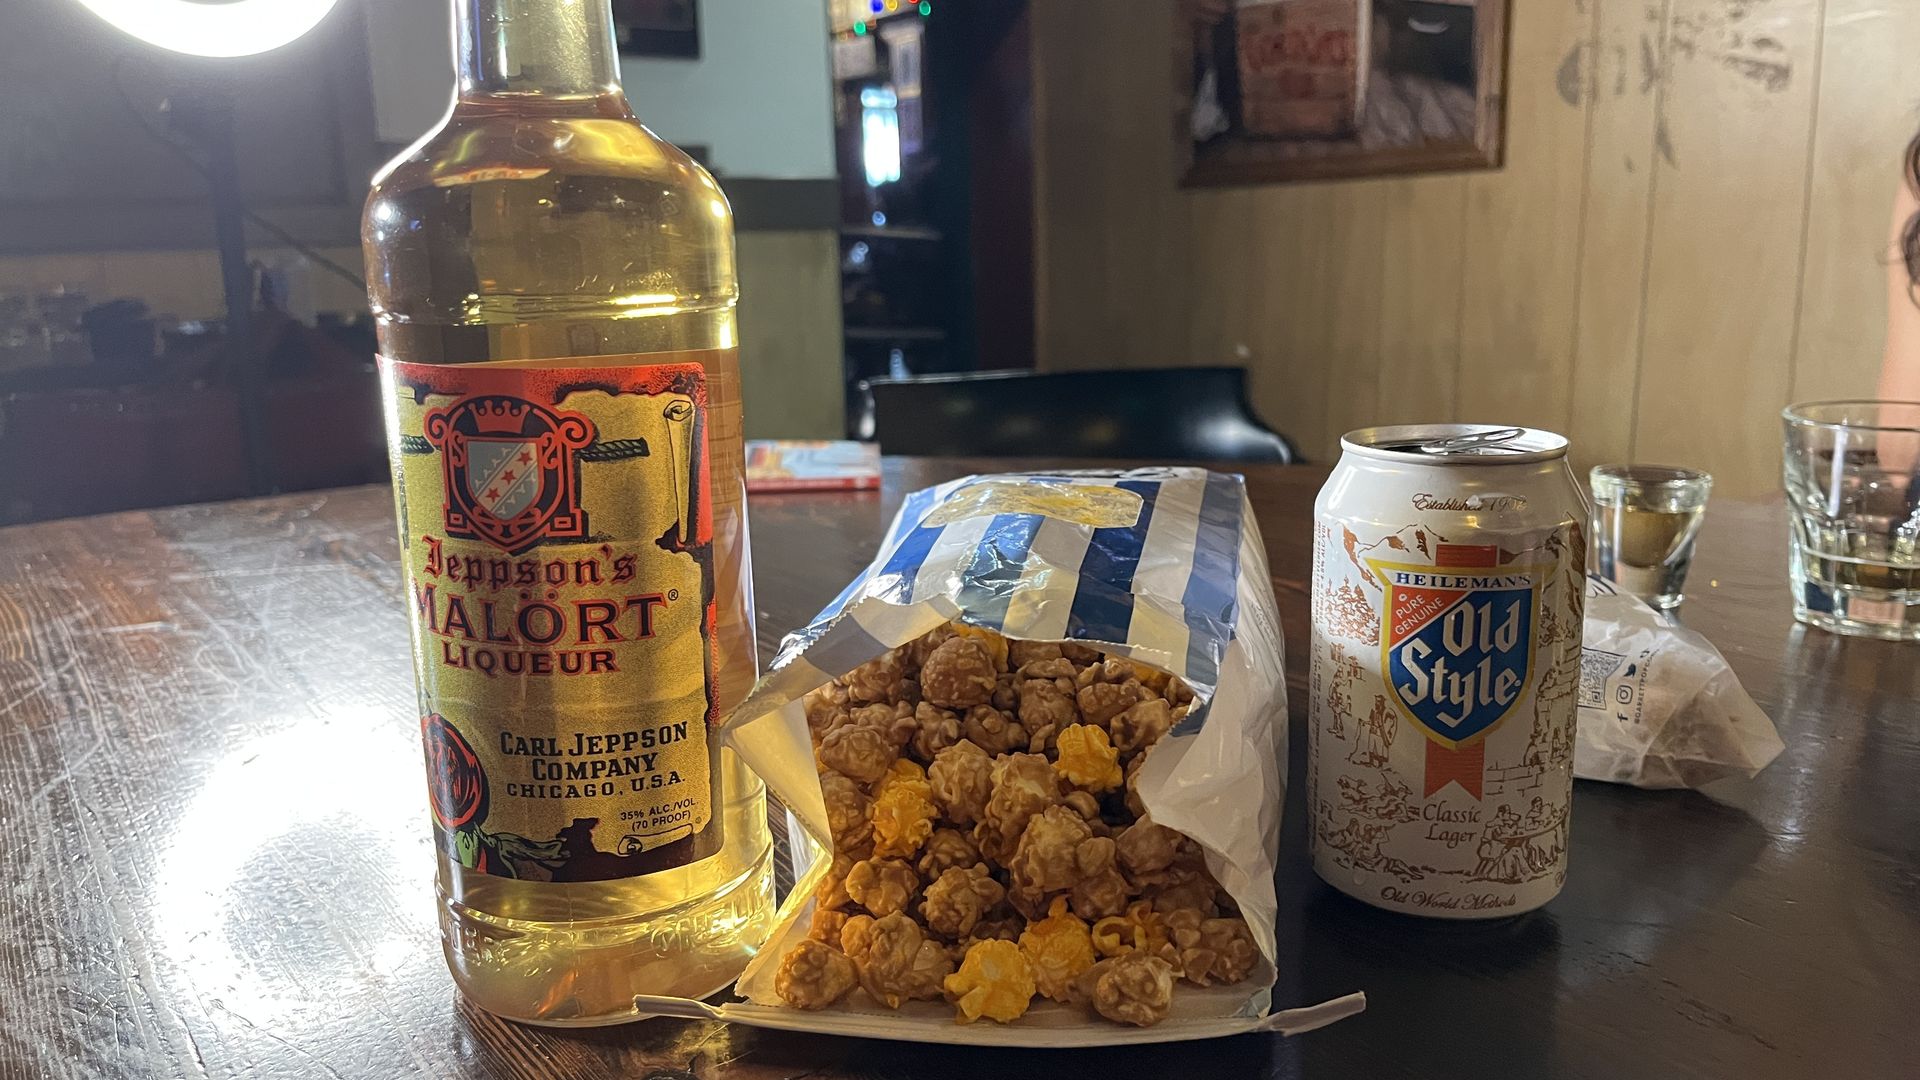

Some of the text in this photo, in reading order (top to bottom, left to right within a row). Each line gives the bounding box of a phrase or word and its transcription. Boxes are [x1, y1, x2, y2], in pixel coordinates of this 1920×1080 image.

[1412, 493, 1483, 511] Establish
[422, 534, 638, 593] Jeppson's
[1396, 572, 1531, 589] HEILEMAN'S
[1395, 597, 1444, 635] GENUINE
[1396, 595, 1426, 619] PURE
[1443, 599, 1520, 657] Old
[442, 642, 620, 676] LIQUEUR
[1399, 637, 1517, 728] Style
[500, 721, 688, 757] CARL JEPPSON
[532, 752, 658, 781] COMPANY
[630, 770, 686, 793] U.S.A.
[621, 808, 645, 821] 35%
[632, 810, 691, 832] (70 PROOF)
[1423, 800, 1481, 823] Classic
[1424, 823, 1477, 849] Lager
[1381, 886, 1410, 903] Old
[1412, 891, 1458, 910] World
